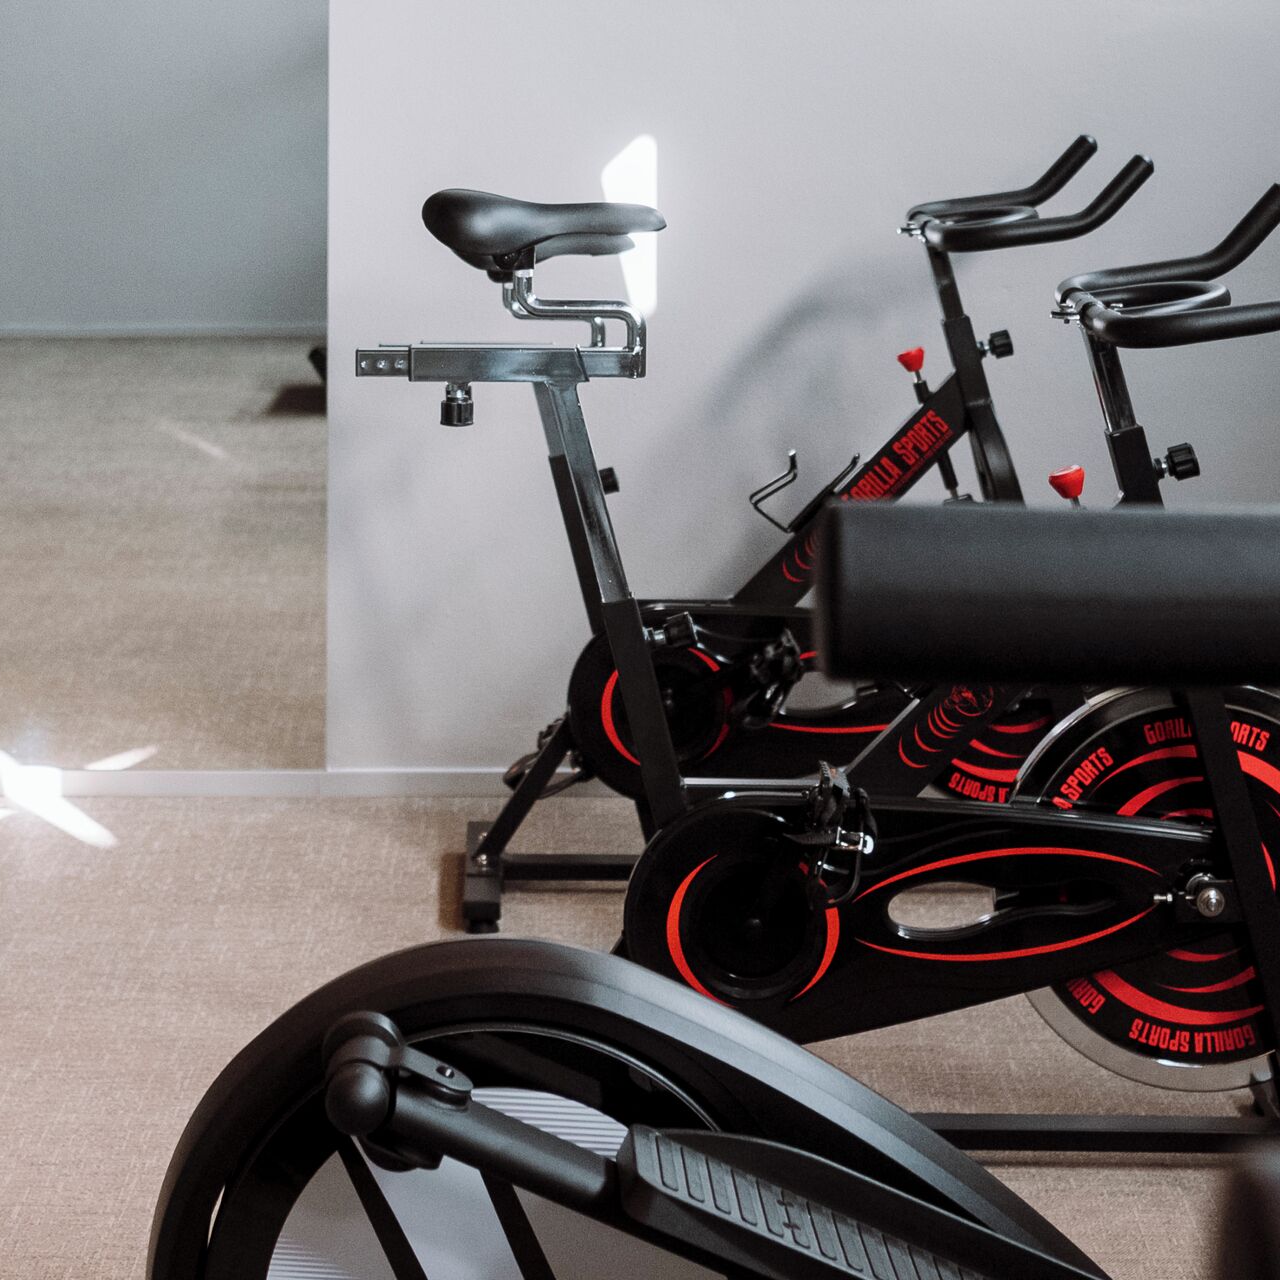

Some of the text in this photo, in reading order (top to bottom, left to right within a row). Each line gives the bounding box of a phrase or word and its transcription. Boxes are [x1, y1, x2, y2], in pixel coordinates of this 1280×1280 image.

[892, 409, 949, 466] SPORTS
[1143, 717, 1192, 745] GORIL
[948, 772, 996, 803] SPORTS
[1059, 746, 1114, 801] SPORTS
[1129, 1017, 1257, 1053] GORILLA SPORTS
